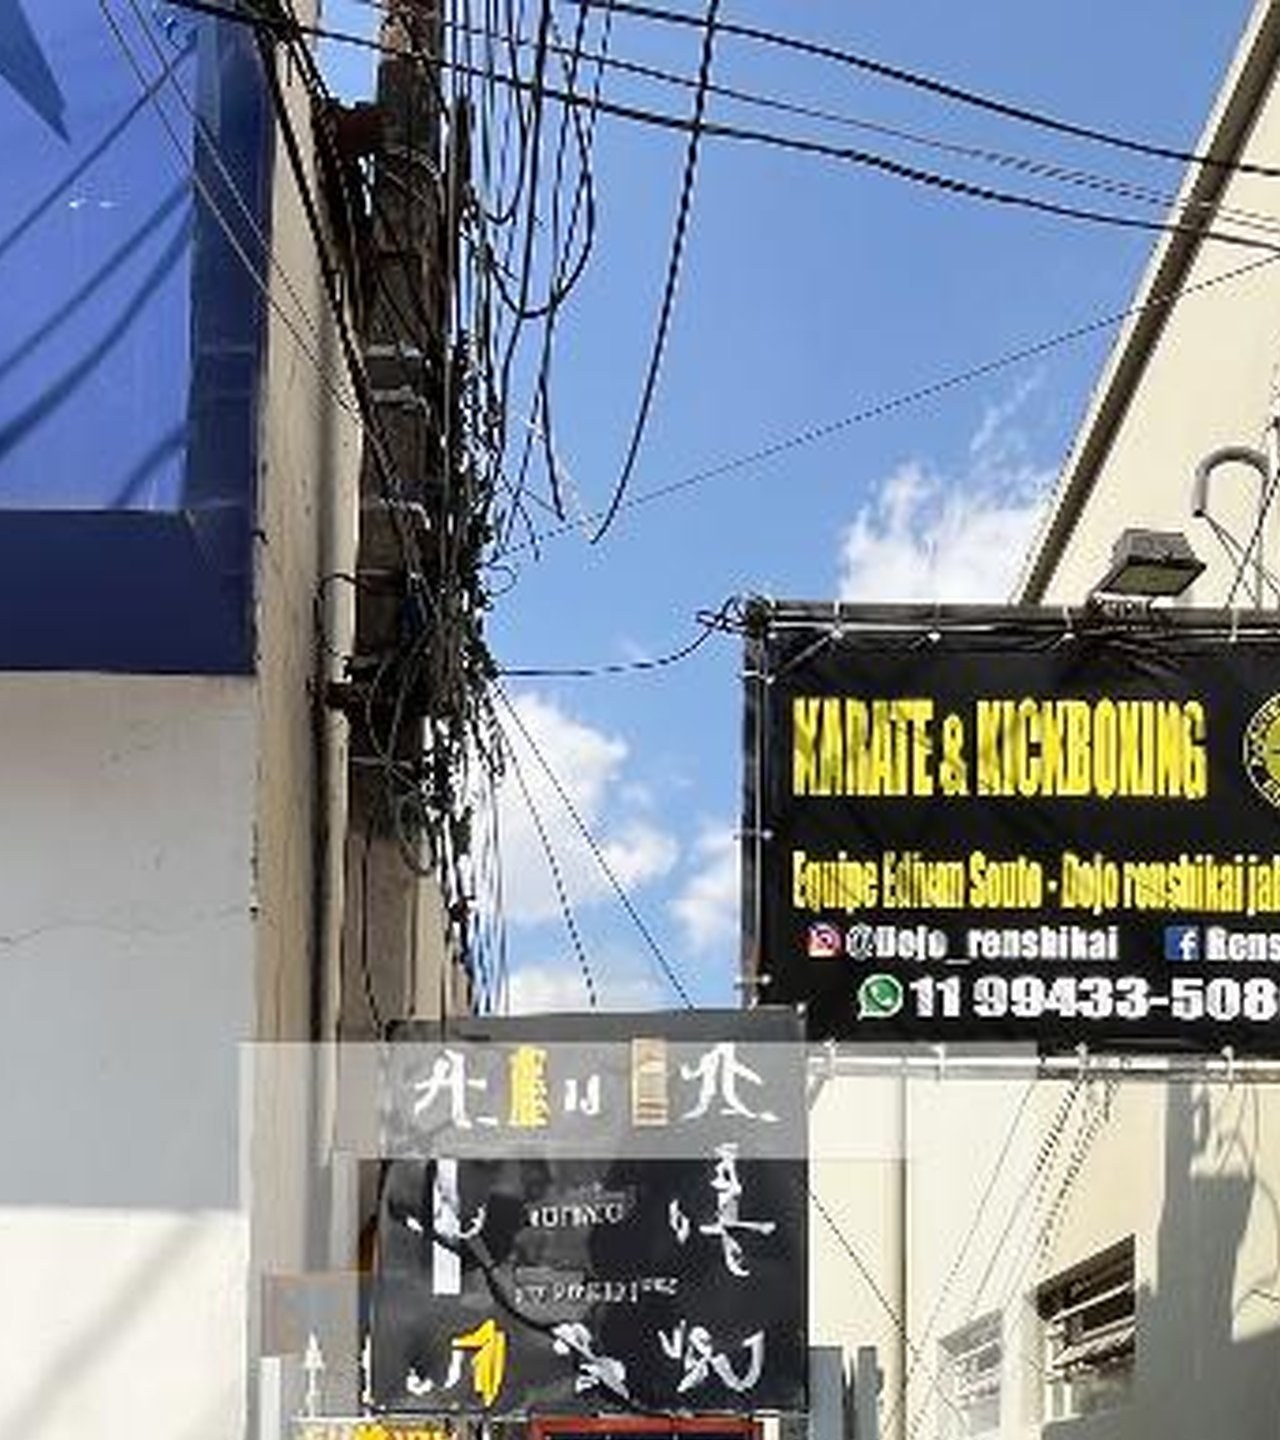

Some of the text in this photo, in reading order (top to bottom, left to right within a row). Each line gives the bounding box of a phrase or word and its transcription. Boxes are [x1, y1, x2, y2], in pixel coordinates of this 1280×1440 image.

[792, 697, 934, 797] KARATE
[939, 713, 969, 797] &
[976, 697, 1208, 799] KICKBOXING
[793, 850, 879, 914] Equipe
[1060, 851, 1119, 916] Dojo
[1123, 853, 1244, 913] renshikai
[909, 975, 961, 1018] 11
